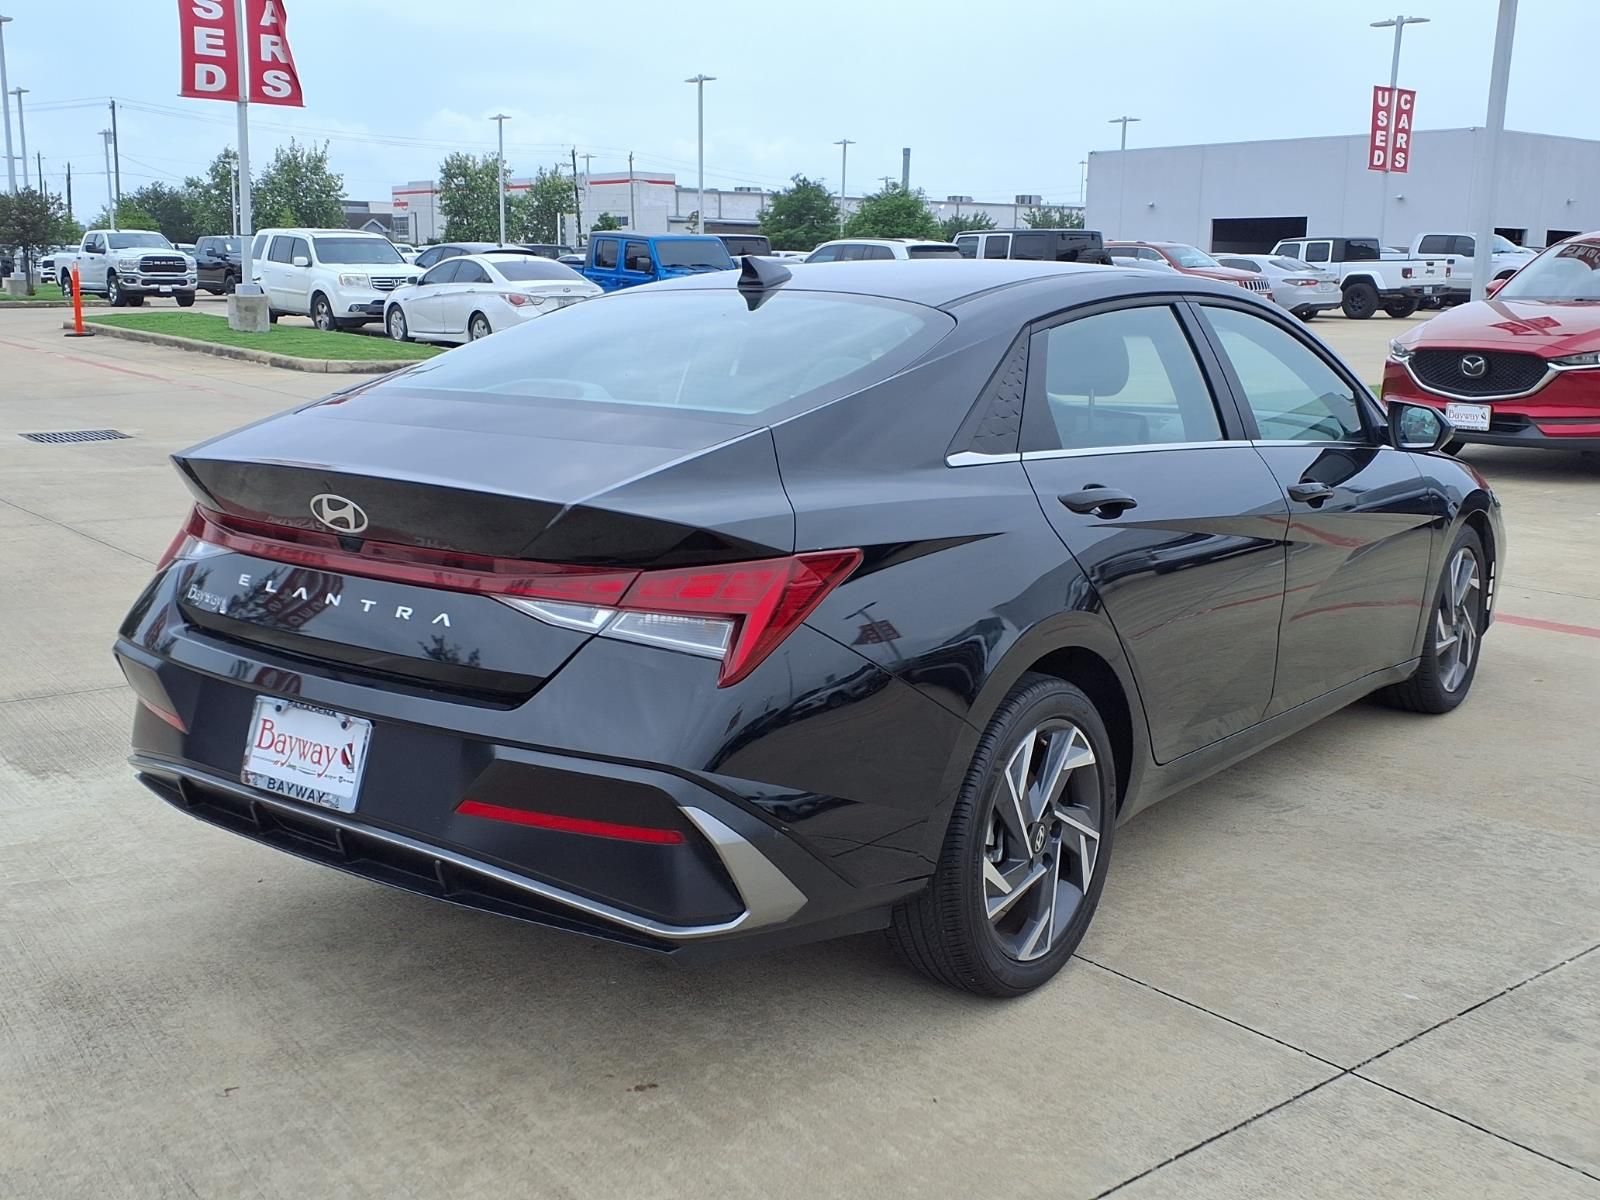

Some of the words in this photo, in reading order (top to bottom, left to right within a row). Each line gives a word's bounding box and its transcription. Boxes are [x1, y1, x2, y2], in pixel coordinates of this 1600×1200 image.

[1373, 91, 1389, 166] USED
[1394, 94, 1411, 168] CARS
[1448, 409, 1479, 421] Bayway
[238, 574, 451, 627] ELANTRA
[255, 718, 338, 778] Bayway
[267, 777, 326, 803] BAYWAY
